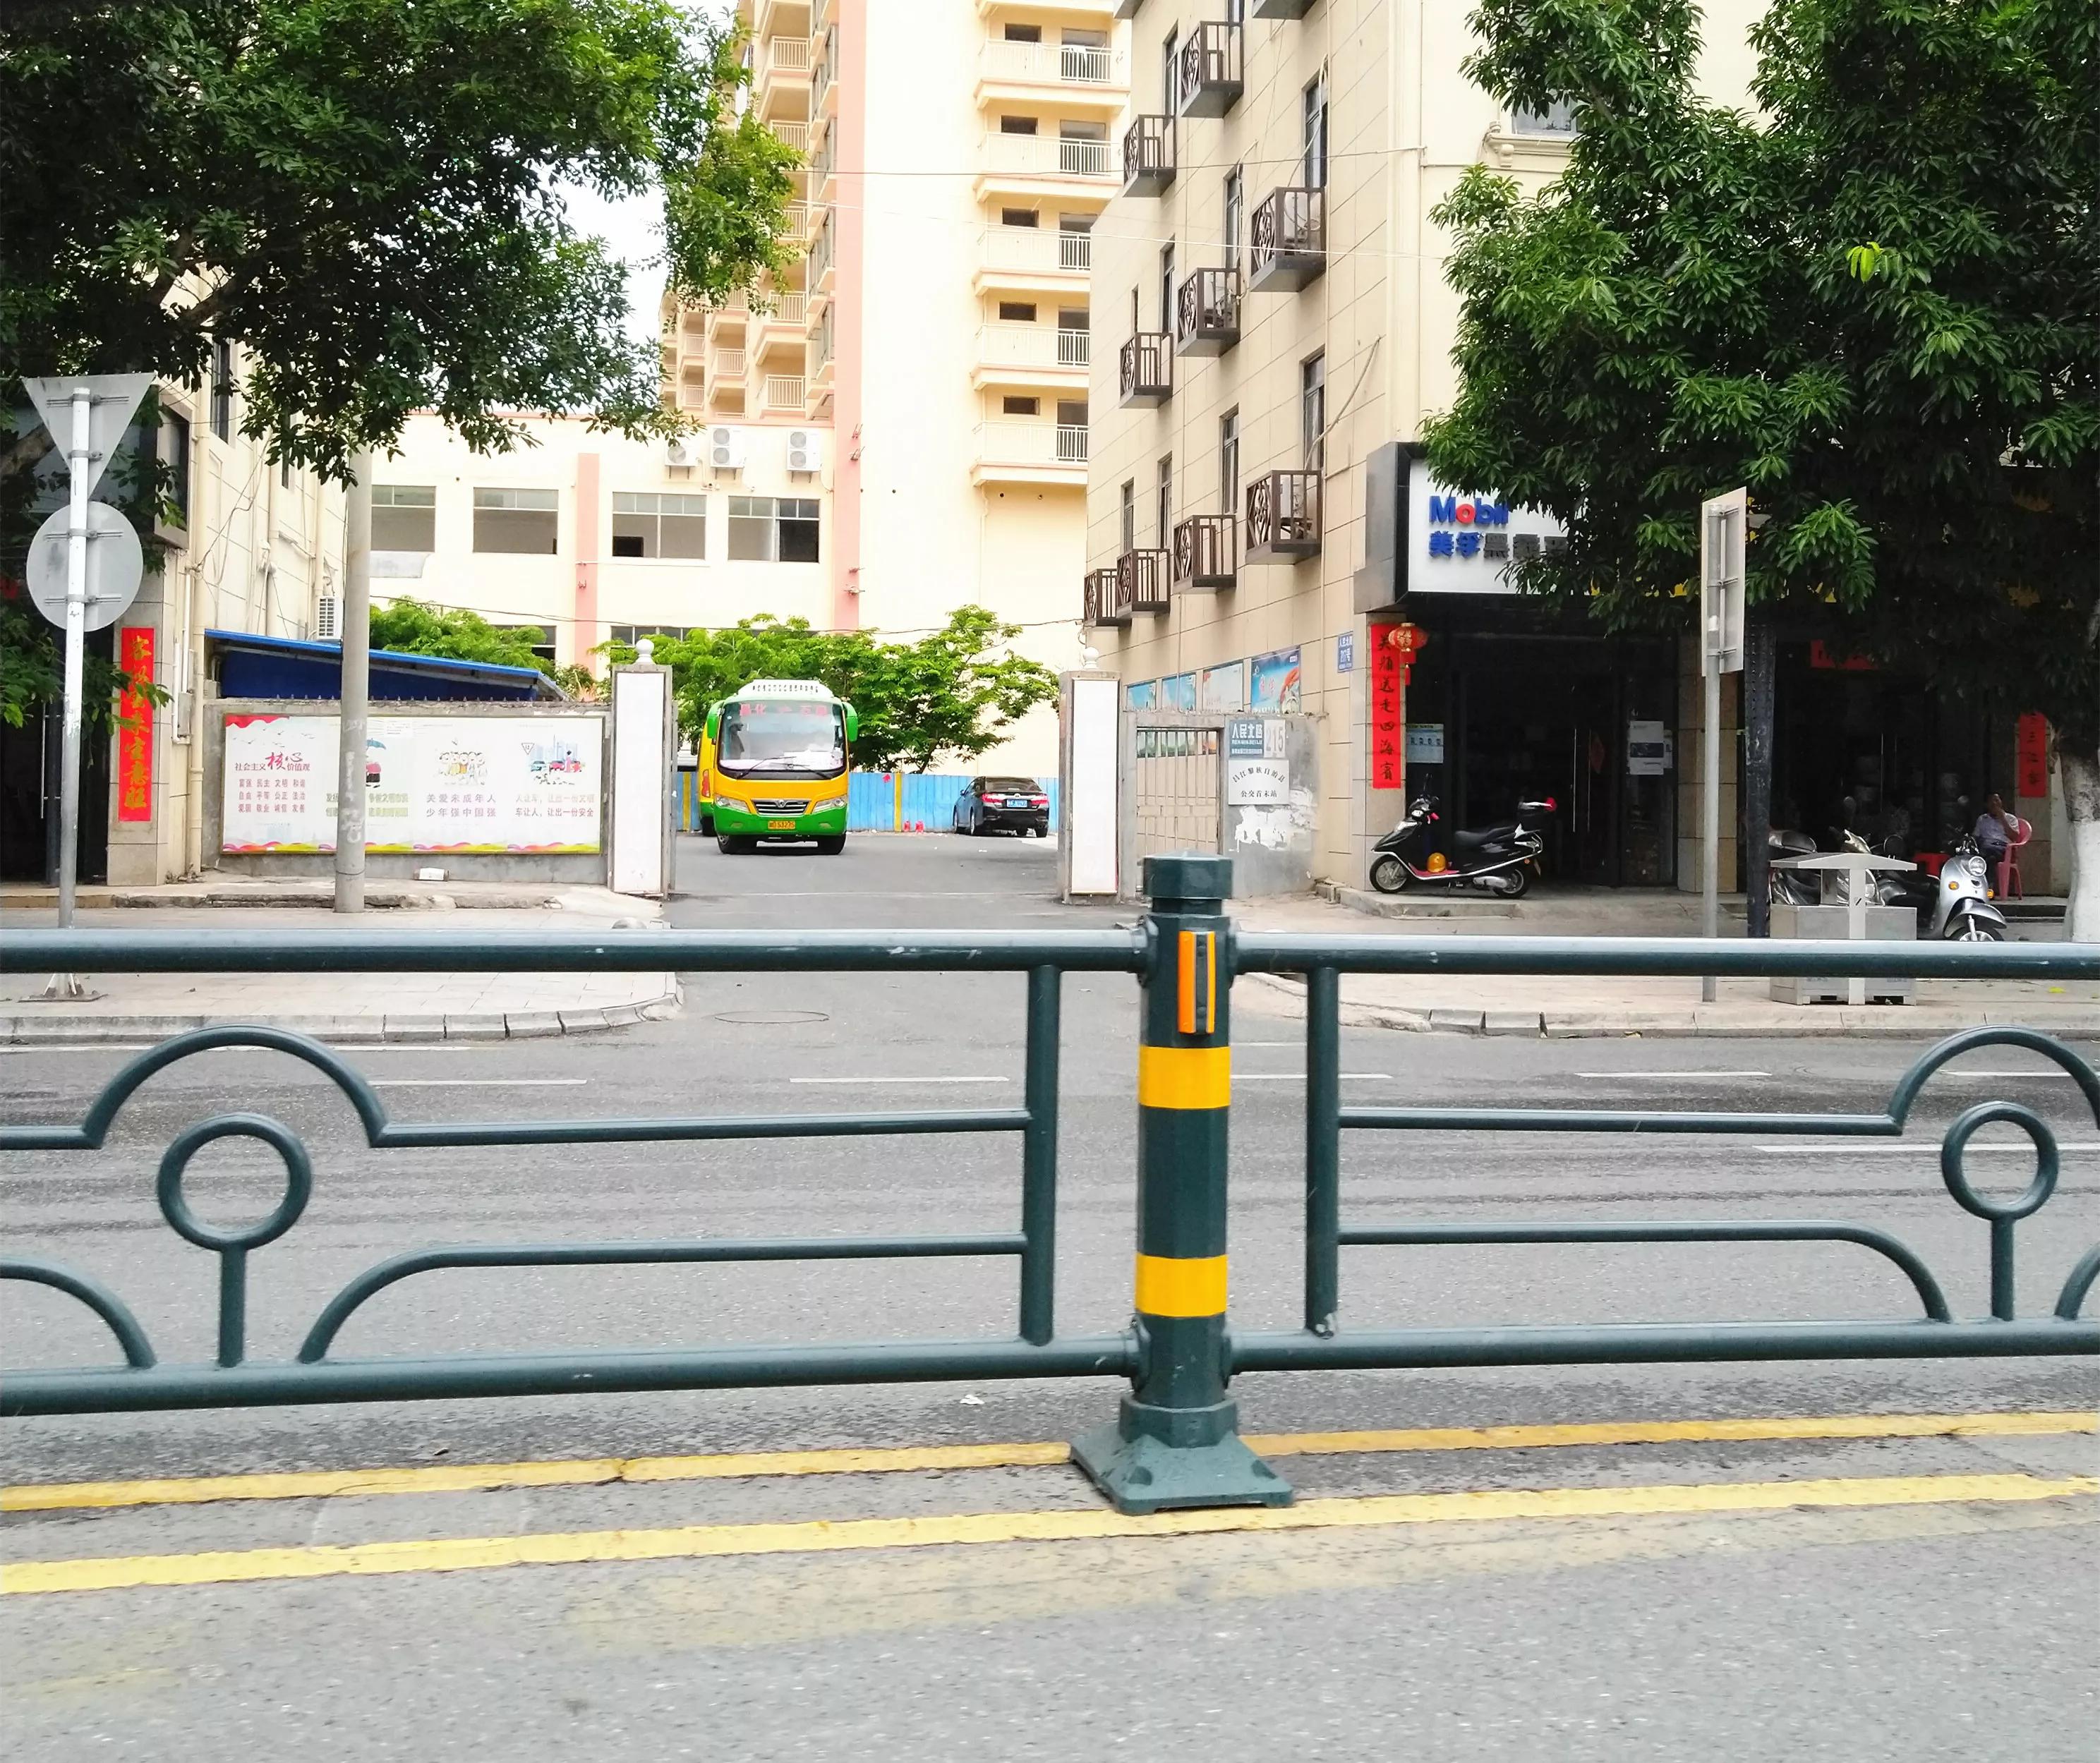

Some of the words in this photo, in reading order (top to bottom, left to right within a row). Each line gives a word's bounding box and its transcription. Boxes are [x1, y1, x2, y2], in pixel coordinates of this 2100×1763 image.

[1429, 495, 1509, 525] Mobil
[1231, 723, 1262, 739] 人民北路
[1266, 727, 1284, 752] 215
[235, 763, 266, 771] 社会主义
[265, 751, 303, 770] 核心
[426, 808, 497, 818] 少年强中国强
